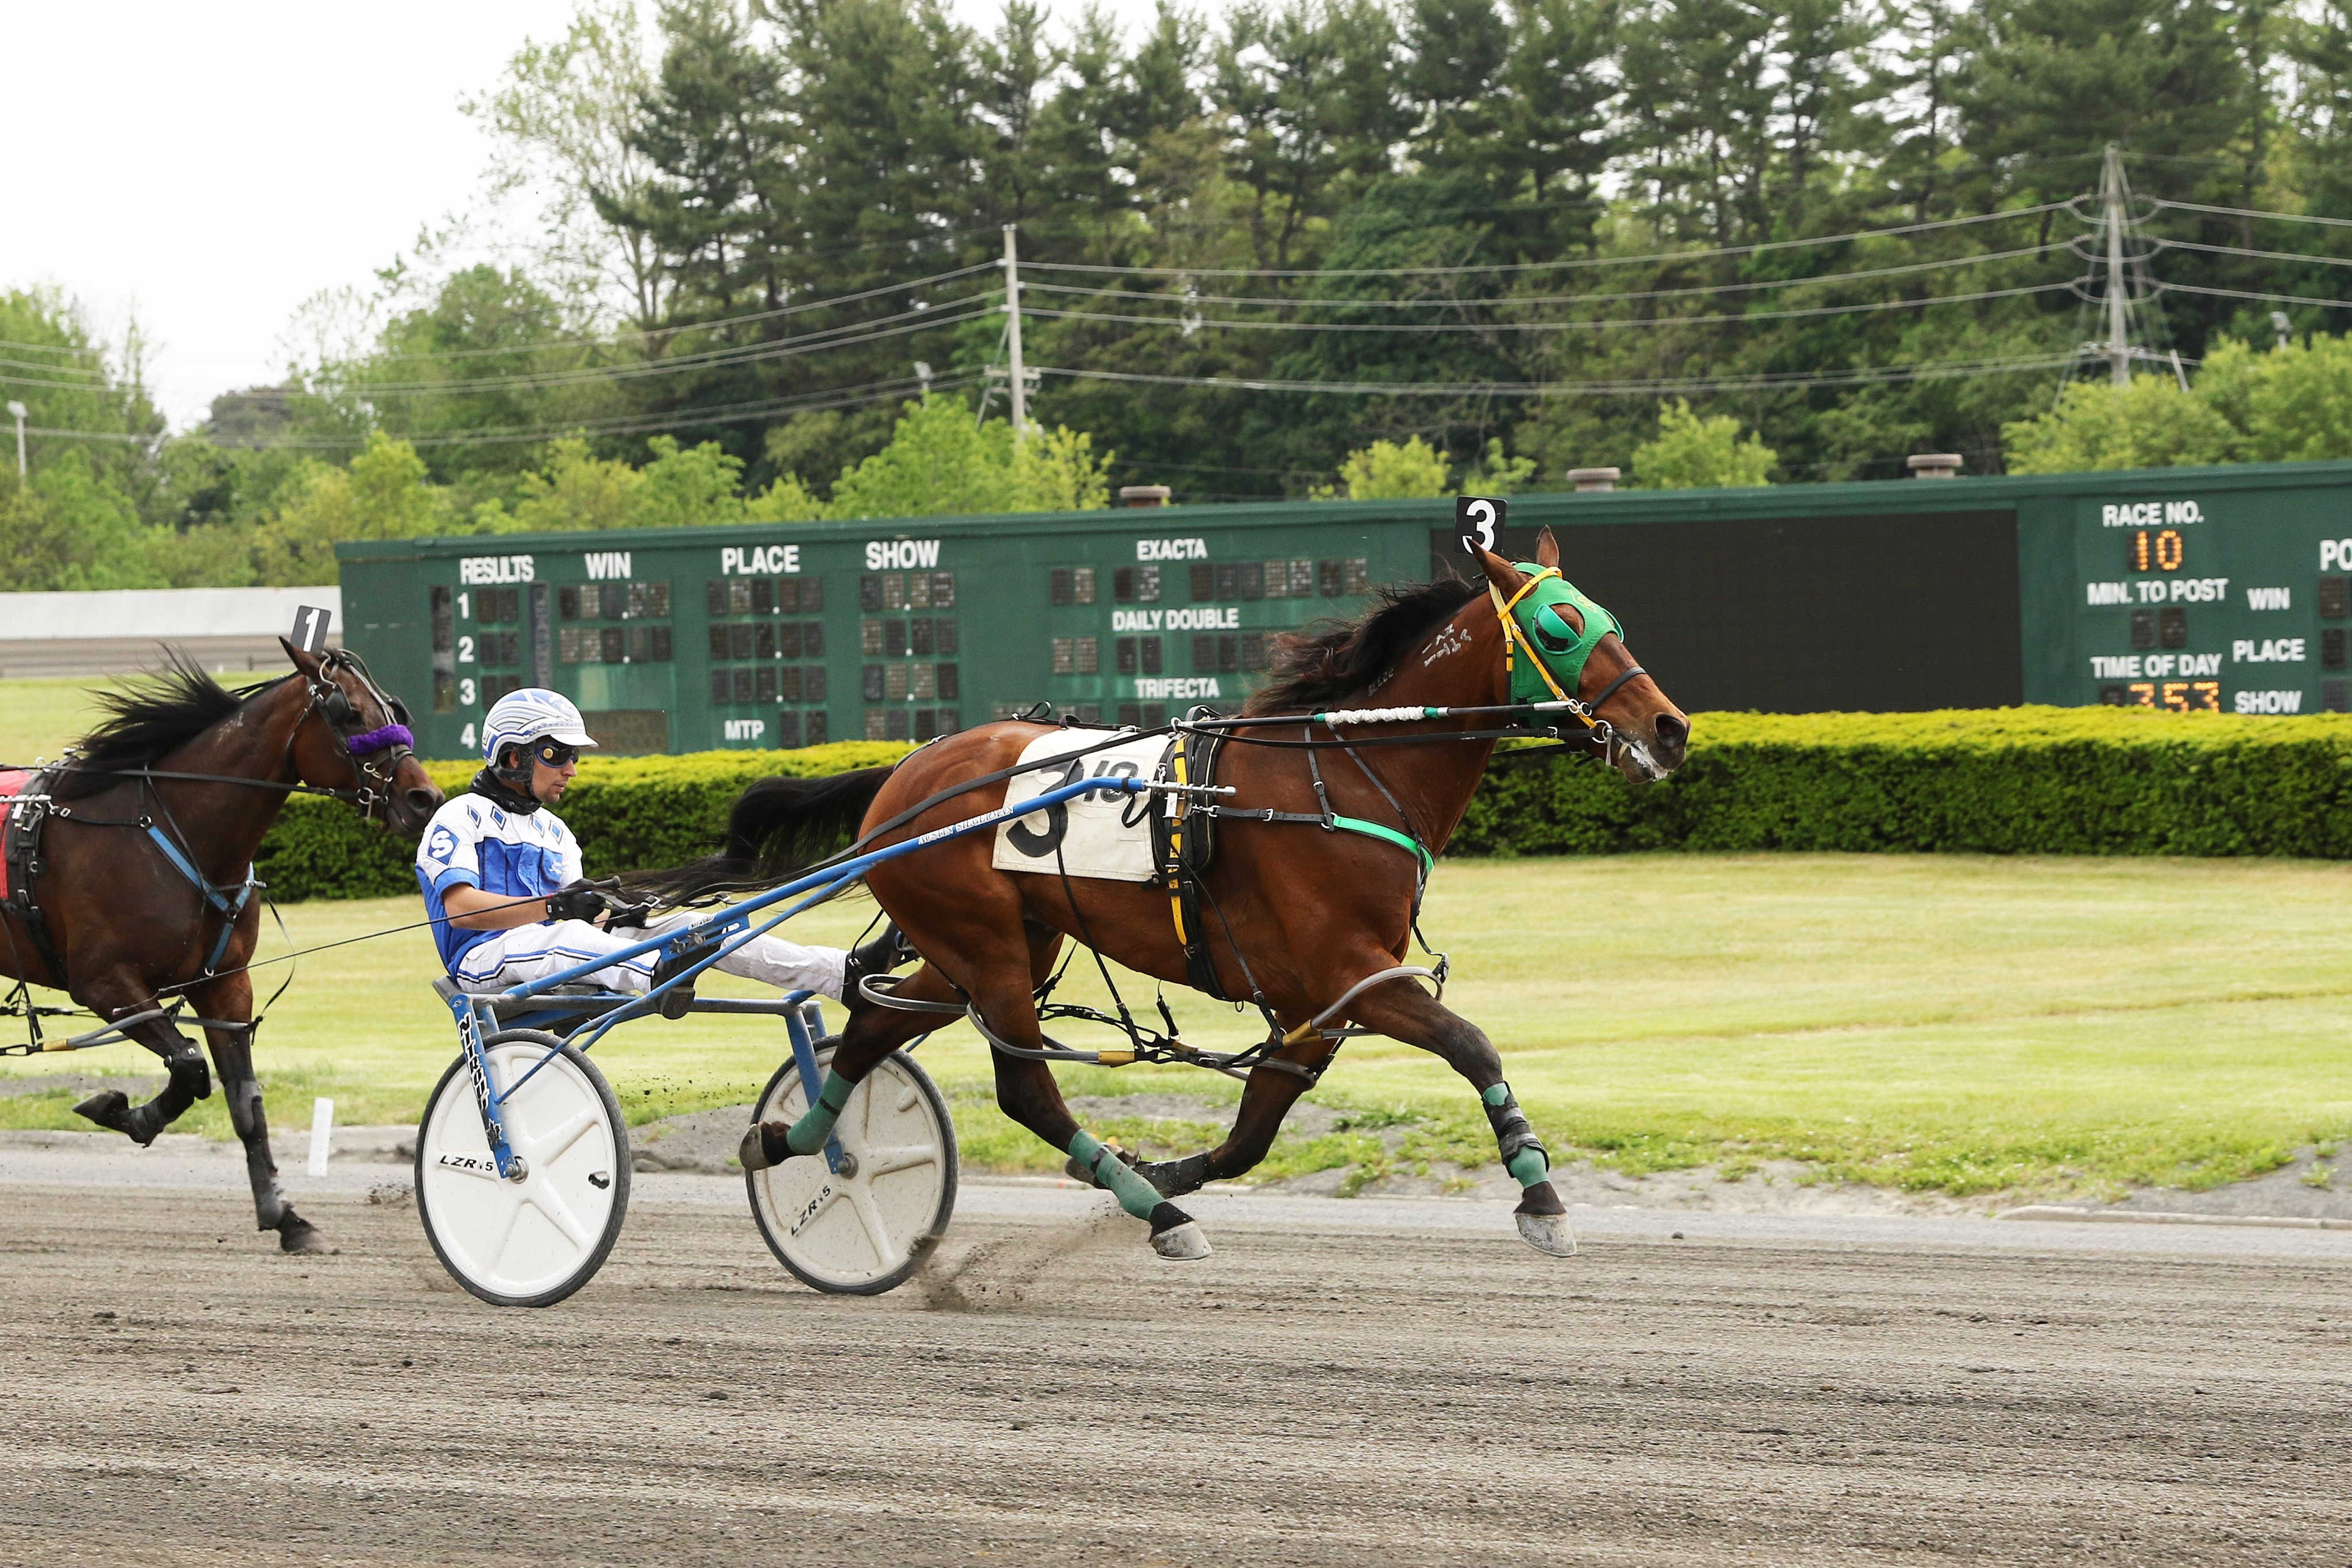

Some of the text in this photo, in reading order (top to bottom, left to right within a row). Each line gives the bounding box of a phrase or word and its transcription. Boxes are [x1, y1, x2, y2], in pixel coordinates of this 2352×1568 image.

[1463, 500, 1496, 554] 3
[2102, 500, 2204, 527] RACE NO.
[721, 544, 800, 575] PLACE
[865, 540, 941, 570] SHOW
[1136, 538, 1208, 561] EXACTA
[2136, 530, 2183, 571] 10
[2320, 538, 2352, 571] PO
[460, 555, 535, 585] RESULTS
[584, 551, 632, 580] WIN
[2087, 578, 2229, 605] MIN. TO POST
[2246, 587, 2291, 610] WIN
[457, 592, 469, 619] 1
[305, 609, 320, 652] 1
[1112, 607, 1240, 632] DAILY DOUBLE
[458, 636, 475, 663] 2
[2233, 638, 2306, 663] PLACE
[2090, 653, 2222, 679] TIME OF DAY
[460, 677, 476, 706] 3
[1134, 677, 1220, 699] TRIFECTA
[2234, 690, 2302, 714] SHOW
[460, 722, 477, 750] 4
[724, 719, 765, 741] MTP
[1006, 756, 1084, 858] 3
[431, 830, 454, 858] S
